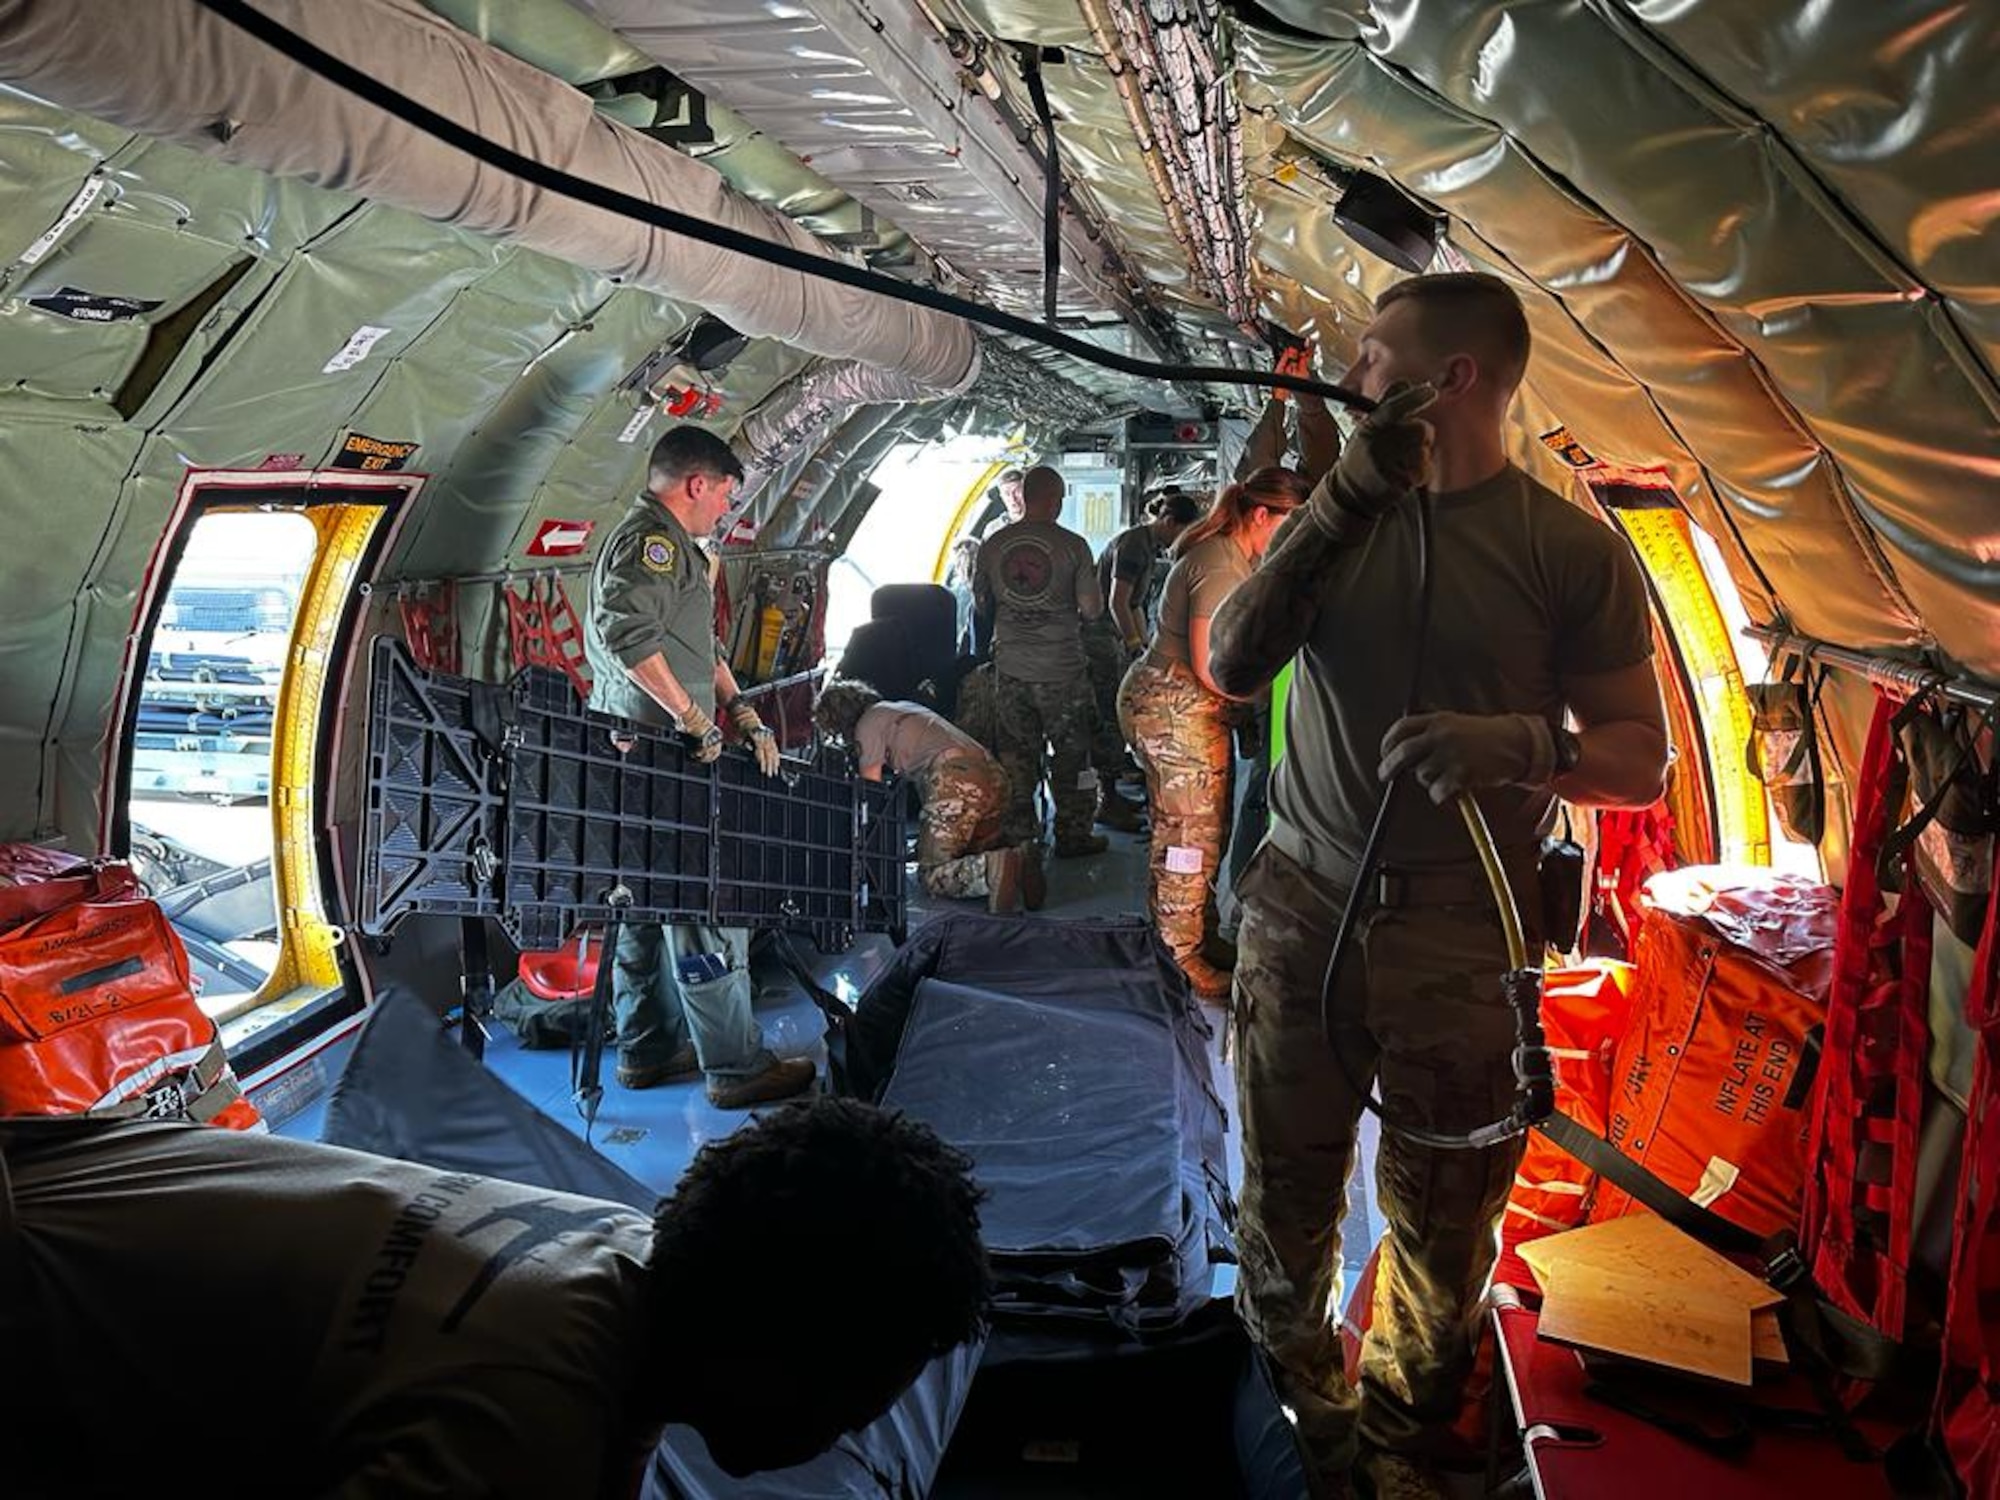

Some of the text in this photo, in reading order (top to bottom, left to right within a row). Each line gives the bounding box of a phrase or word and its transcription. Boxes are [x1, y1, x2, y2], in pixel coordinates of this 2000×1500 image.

[71, 307, 113, 319] STOWAGE
[346, 435, 415, 457] EMERGENCY
[361, 455, 391, 470] EXIT
[1715, 1012, 1767, 1116] INFLATE AT
[1743, 1040, 1791, 1125] THIS END
[345, 1192, 452, 1353] COMFORT
